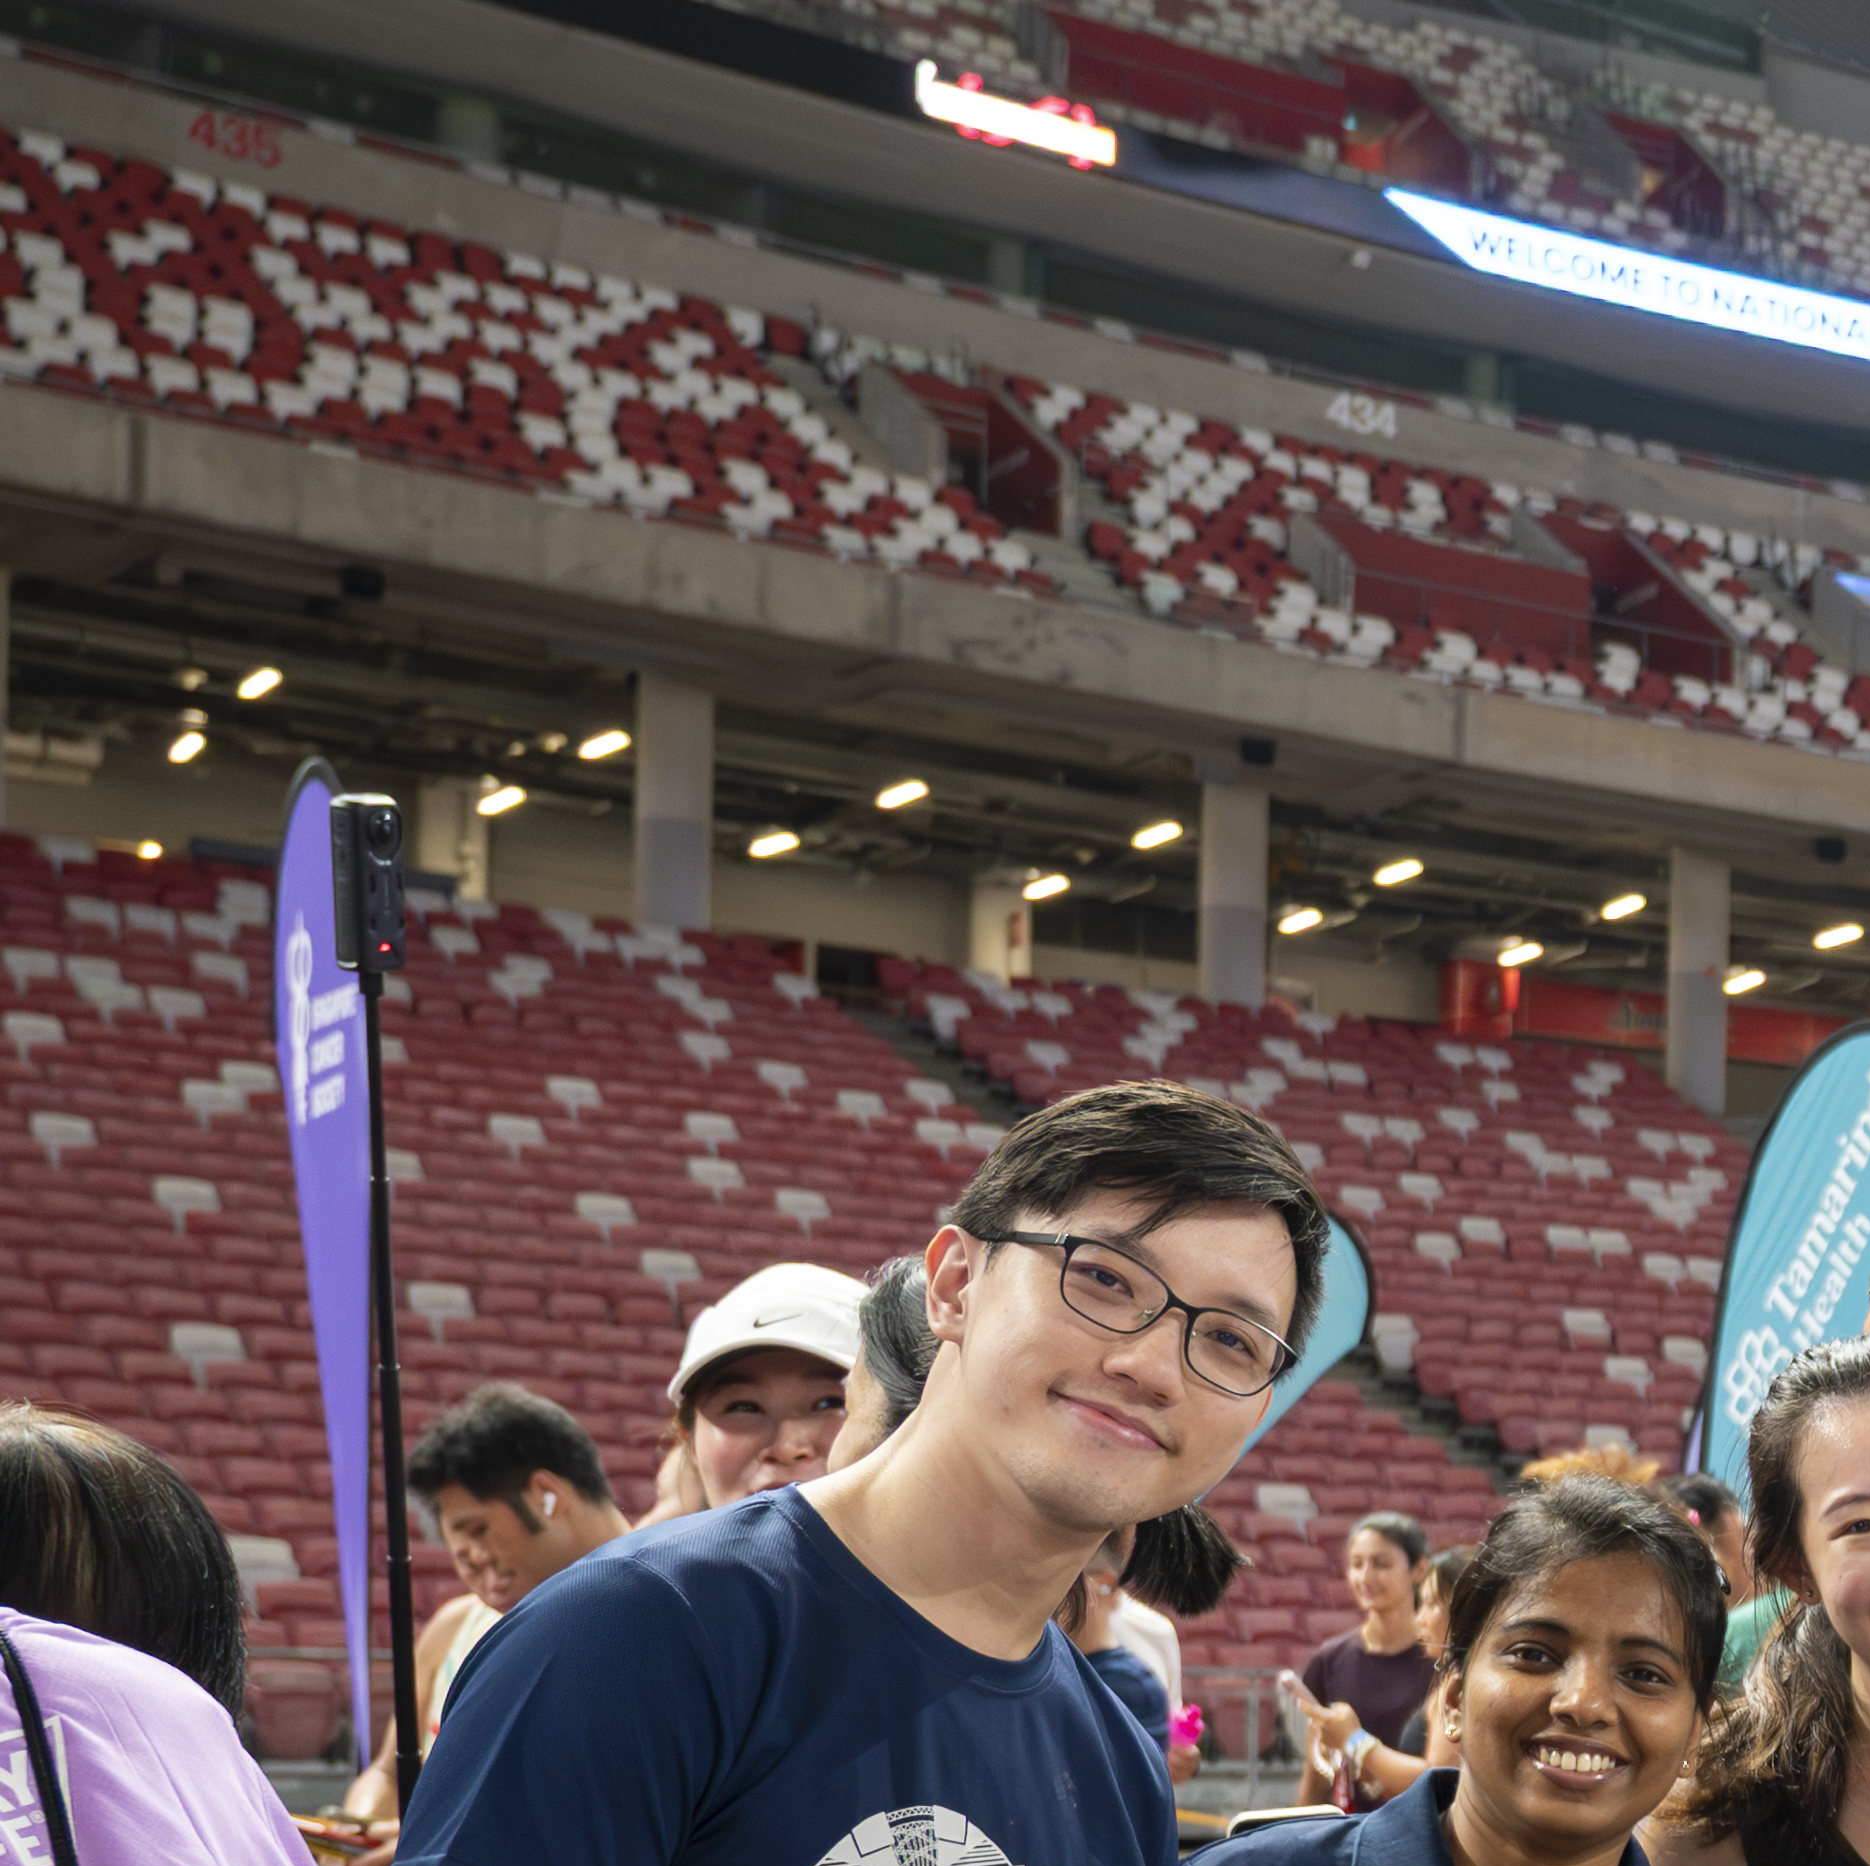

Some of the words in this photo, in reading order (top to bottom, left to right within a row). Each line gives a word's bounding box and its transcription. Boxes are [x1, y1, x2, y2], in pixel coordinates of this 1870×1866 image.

[188, 110, 283, 169] 435
[1471, 226, 1647, 296] WELCOME
[1661, 273, 1701, 307] TO
[1326, 391, 1399, 439] 434
